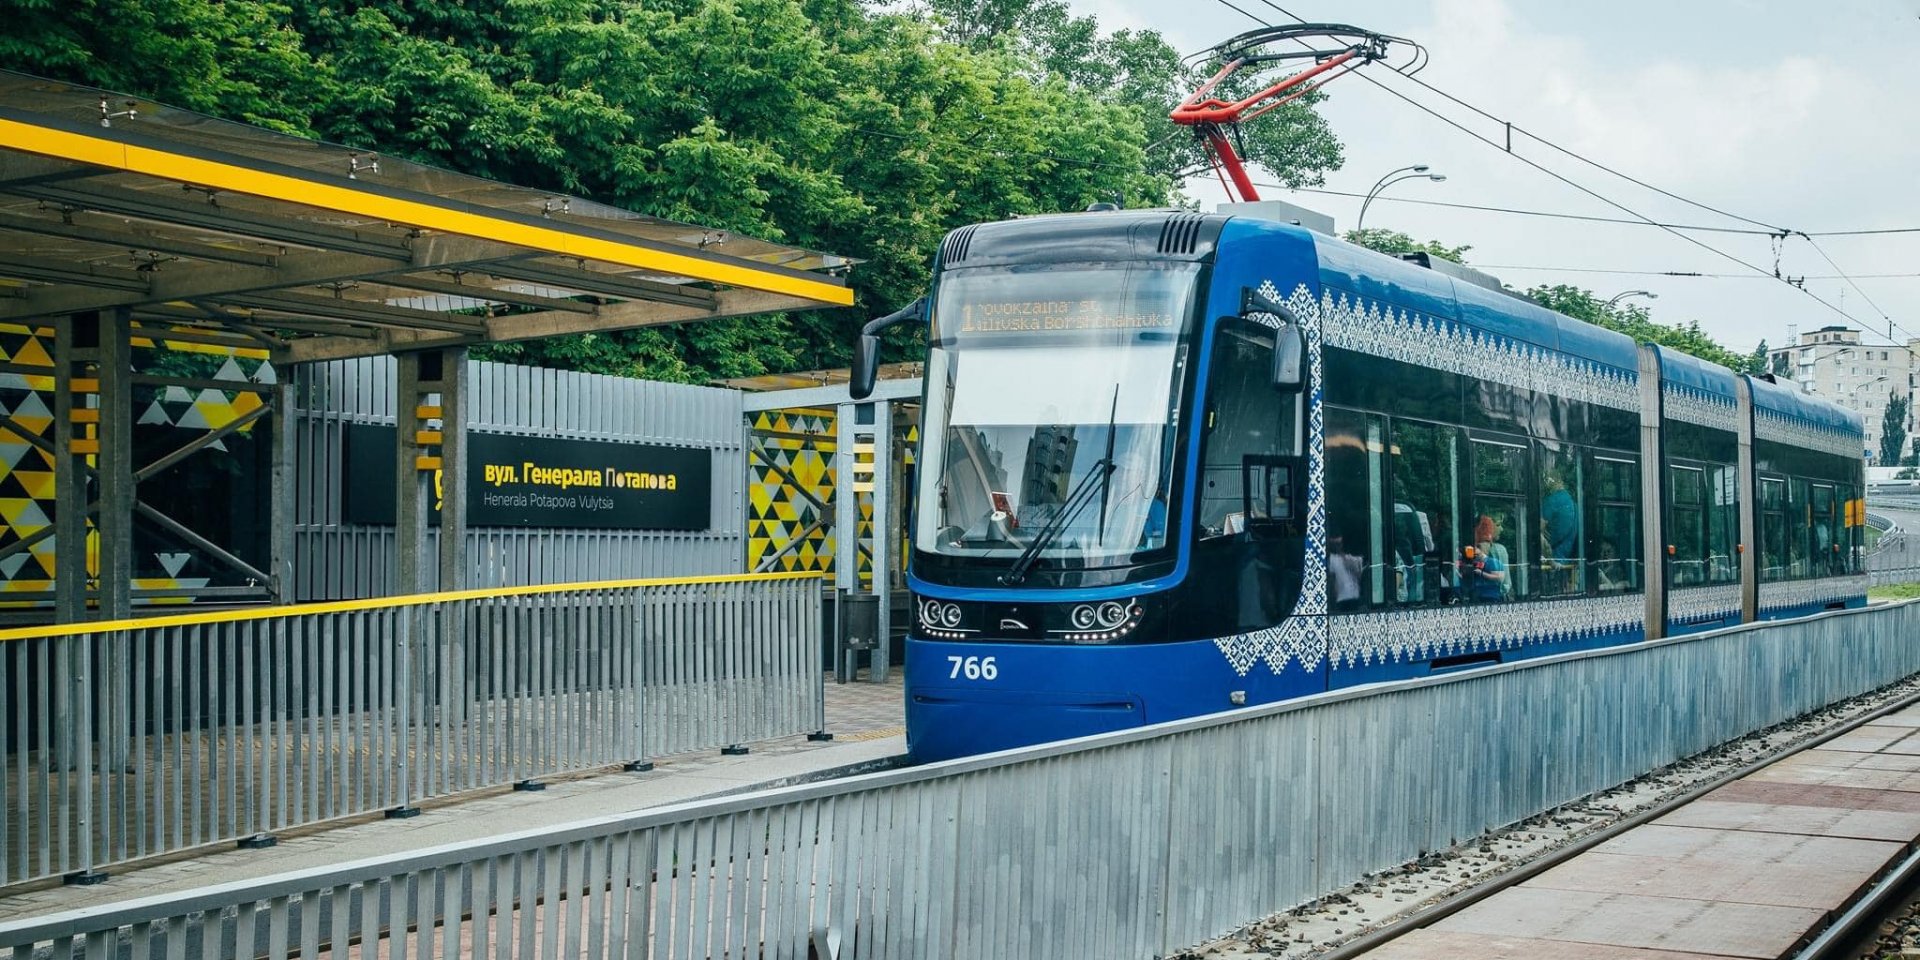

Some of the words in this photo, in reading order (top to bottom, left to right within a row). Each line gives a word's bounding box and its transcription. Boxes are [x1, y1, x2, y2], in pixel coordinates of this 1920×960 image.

[961, 304, 975, 331] 1
[485, 464, 518, 486] вул.
[523, 462, 602, 489] Генерала
[606, 467, 676, 490] Потапова
[484, 492, 527, 506] Henerala
[530, 493, 576, 509] Potapova
[579, 496, 613, 511] Vulytsia
[947, 655, 998, 681] 766
